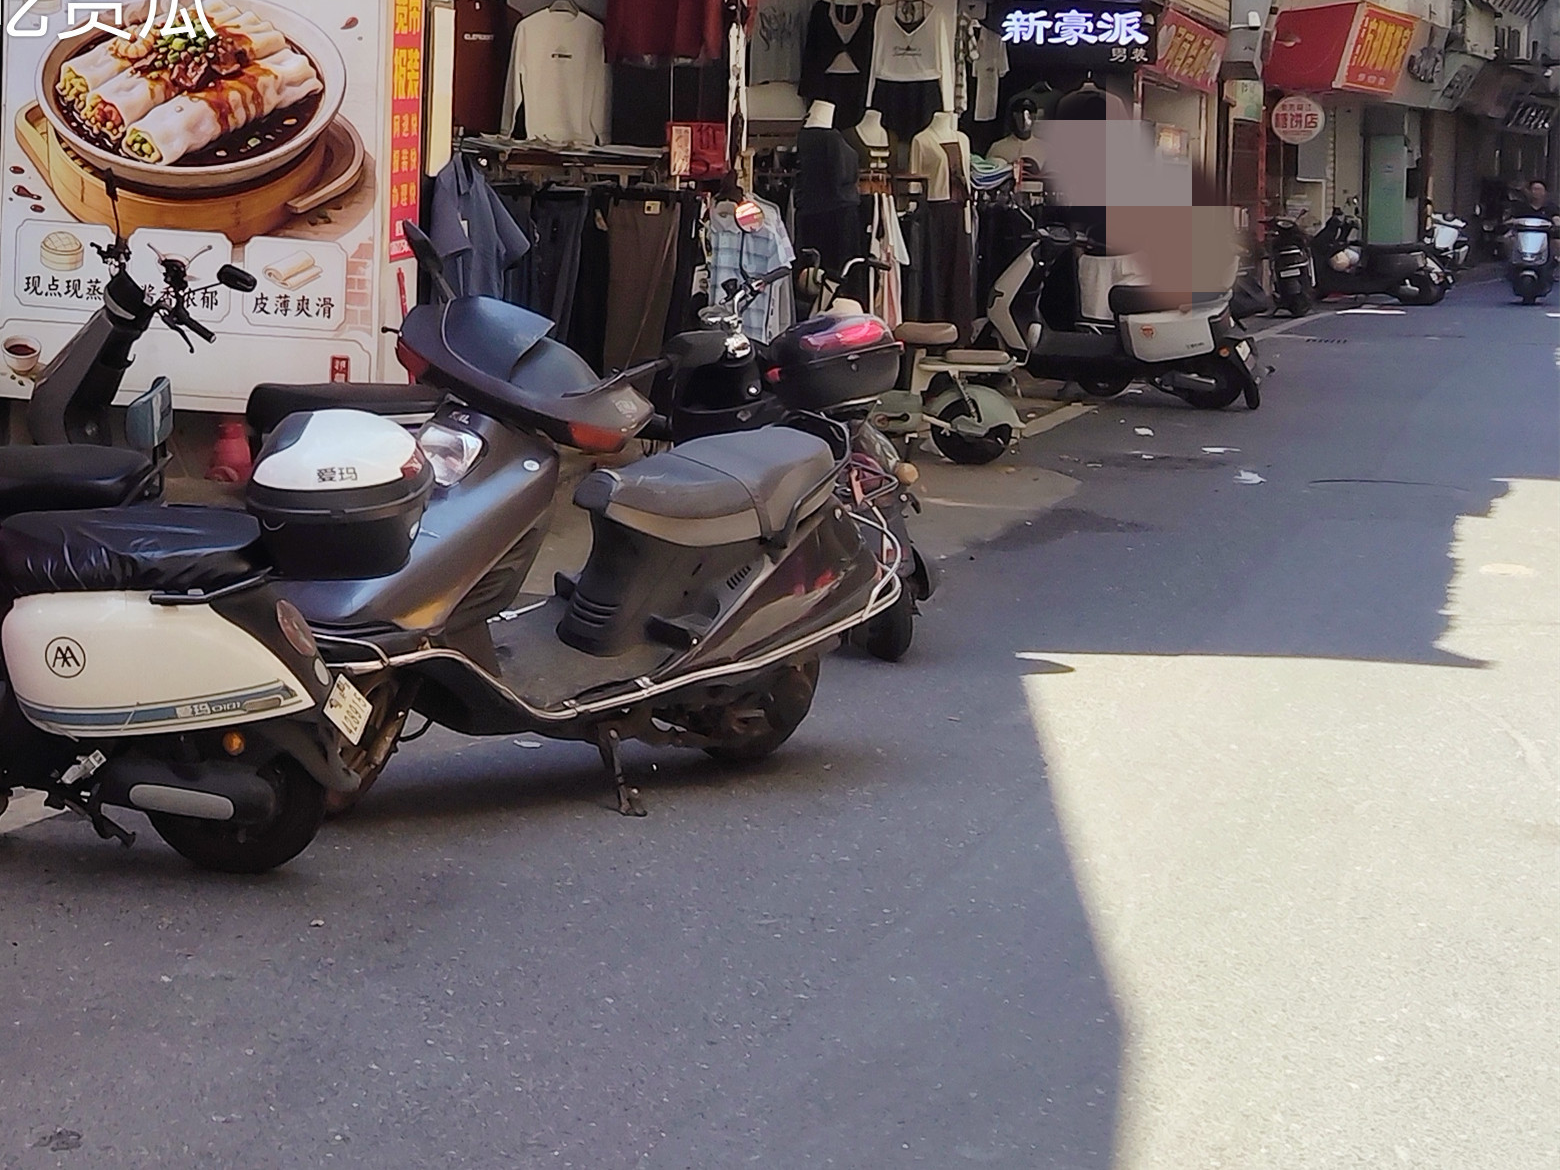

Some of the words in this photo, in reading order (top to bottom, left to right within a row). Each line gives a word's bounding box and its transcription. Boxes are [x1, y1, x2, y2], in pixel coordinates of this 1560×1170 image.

[1000, 9, 1150, 46] 新豪派
[1108, 47, 1149, 63] 男装
[23, 274, 105, 302] 现点现蒸
[252, 293, 336, 320] 皮薄爽滑
[317, 466, 358, 483] 爱玛
